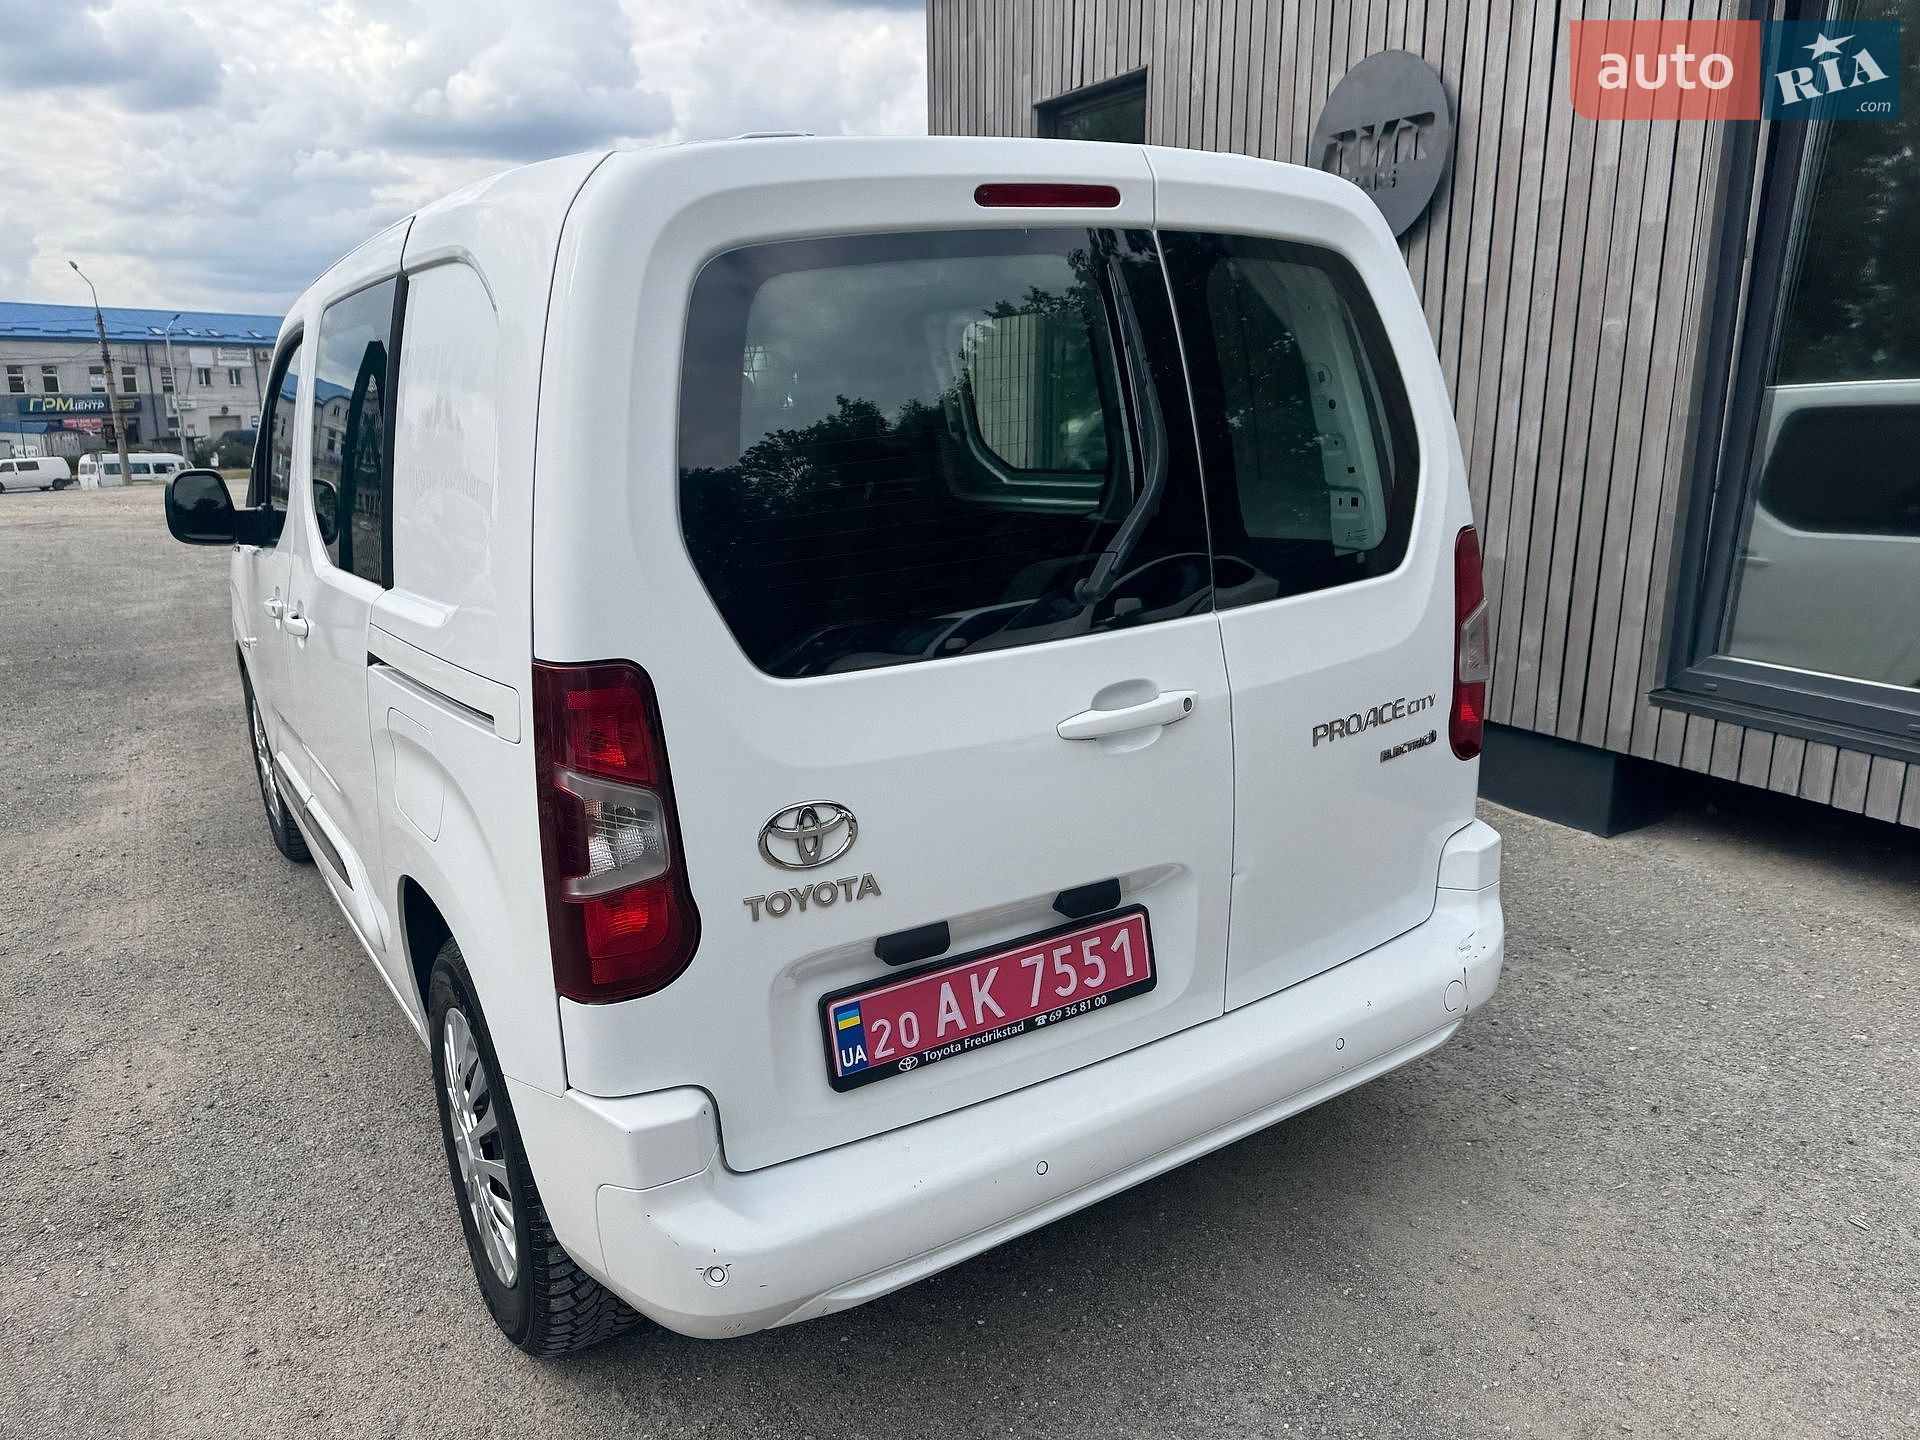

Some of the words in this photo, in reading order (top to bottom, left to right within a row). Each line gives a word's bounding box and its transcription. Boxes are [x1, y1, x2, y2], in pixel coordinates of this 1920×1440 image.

[29, 397, 74, 412] ГРМ
[1312, 697, 1406, 748] PROACE
[1407, 693, 1436, 715] CITY
[743, 872, 882, 922] TOYOTA
[870, 1010, 921, 1060] 20
[936, 966, 1006, 1039] AK
[1020, 928, 1135, 1009] 7551
[1049, 1009, 1063, 1022] 69
[1064, 1004, 1078, 1017] 36
[1079, 999, 1092, 1012] 81
[1094, 994, 1108, 1007] 00
[841, 1044, 868, 1068] UA
[923, 1043, 962, 1062] Toyota
[964, 1021, 1025, 1049] Fredrikstad
